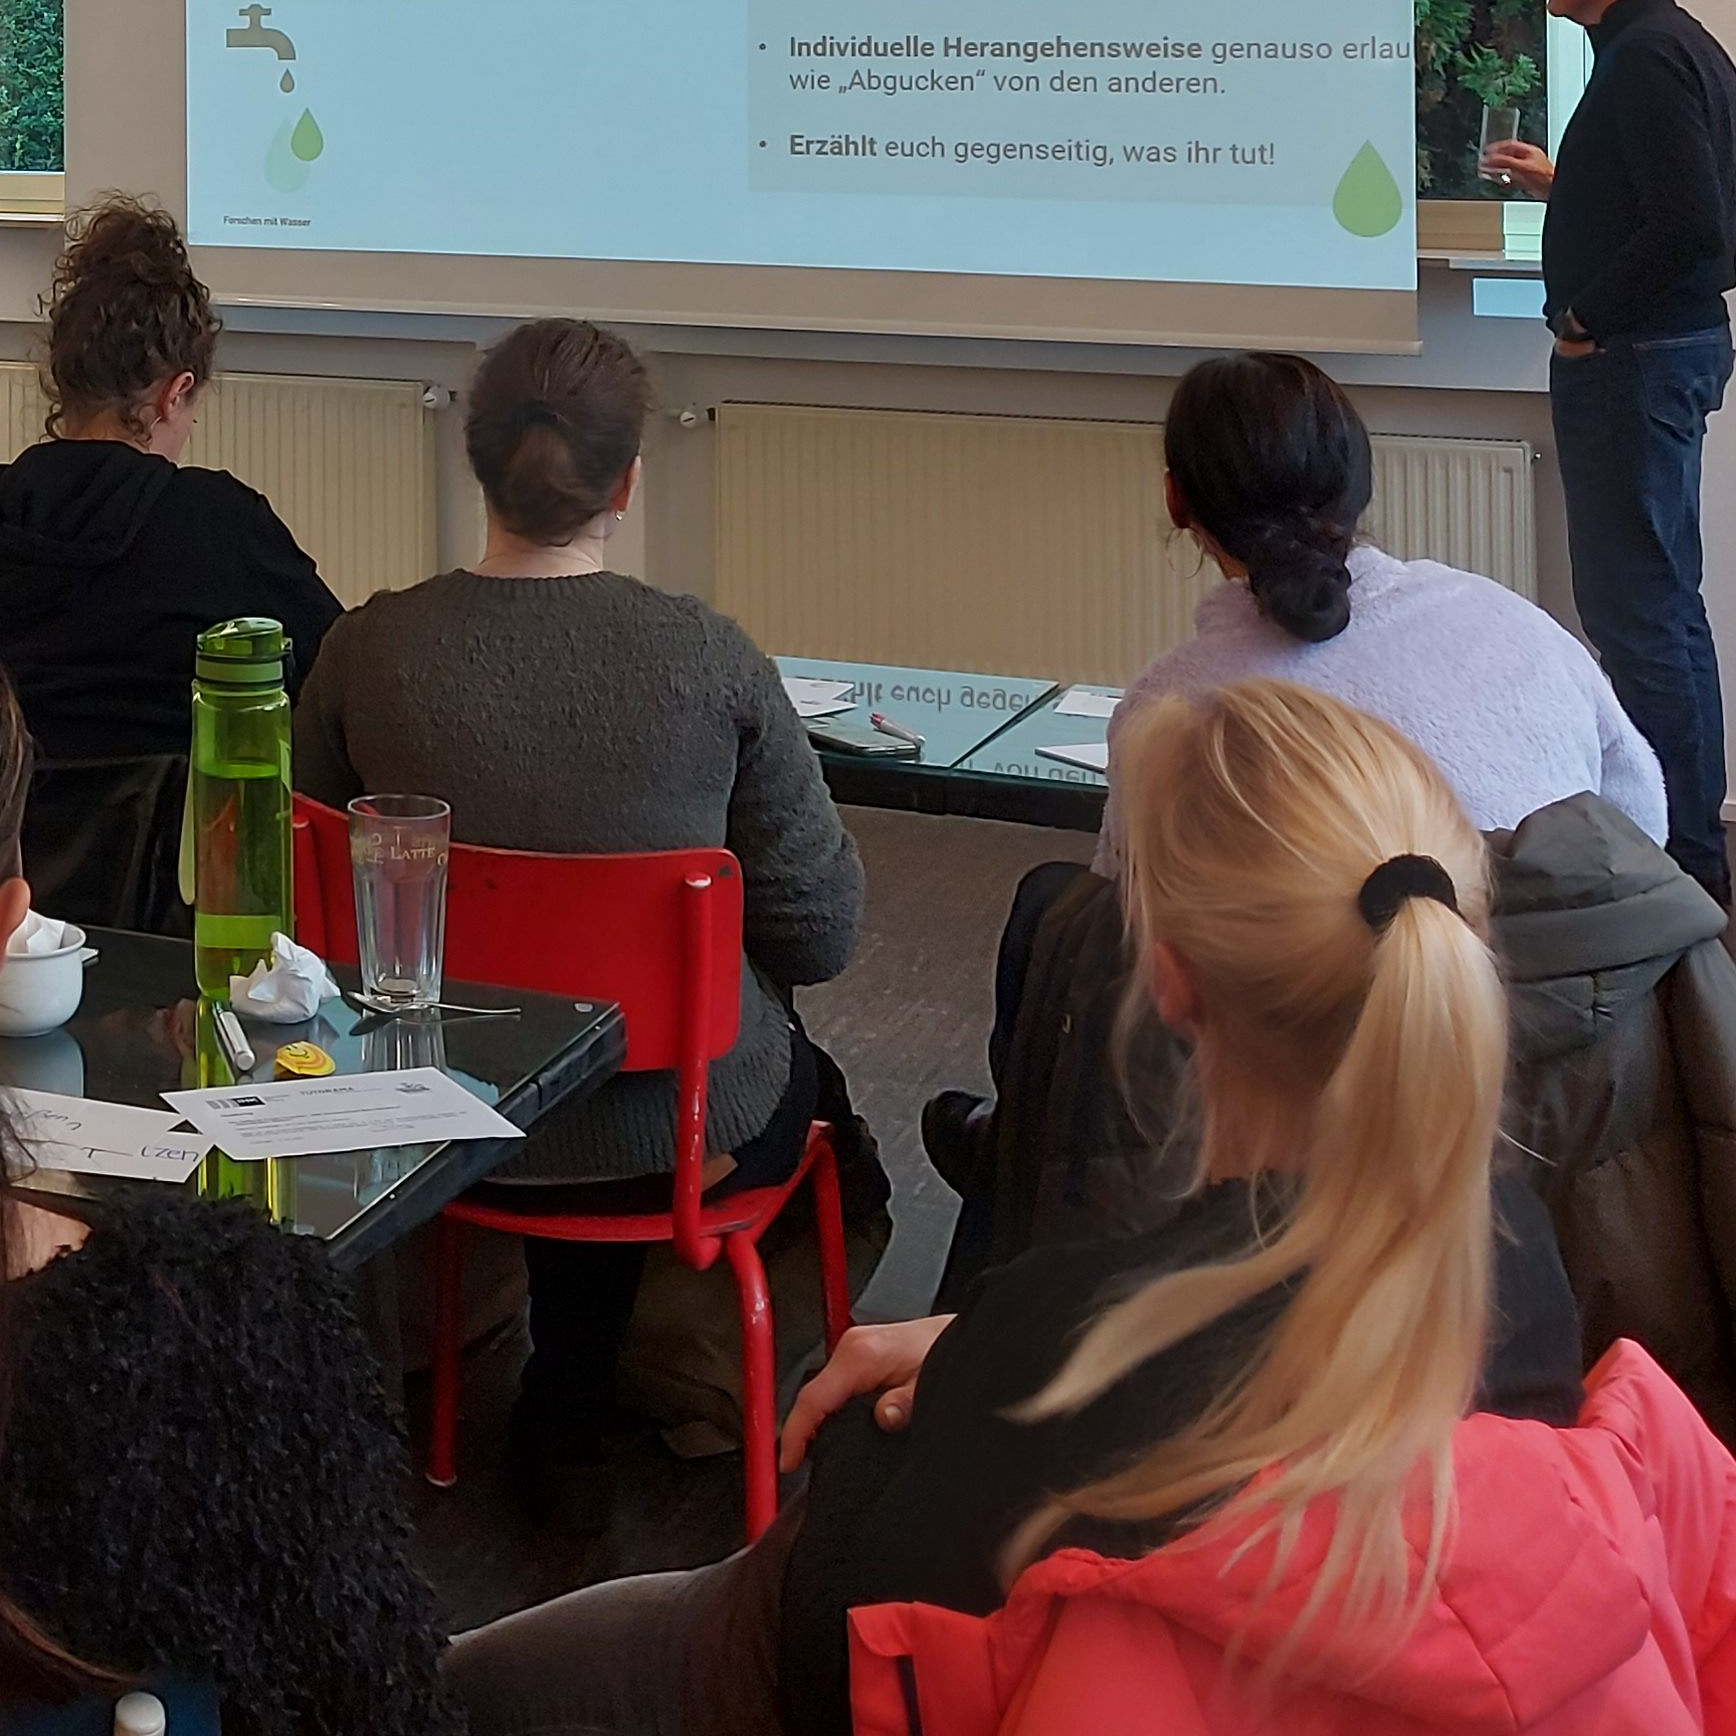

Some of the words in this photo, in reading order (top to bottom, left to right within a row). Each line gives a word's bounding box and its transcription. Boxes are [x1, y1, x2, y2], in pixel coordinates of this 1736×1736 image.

[790, 36, 935, 57] Individuelle
[943, 36, 1202, 62] Herangehensweise
[1212, 40, 1333, 64] genauso
[1342, 36, 1411, 60] erlau
[790, 69, 830, 90] wie
[994, 74, 1039, 92] von
[1049, 70, 1098, 92] den
[1108, 70, 1225, 94] anderen.
[790, 134, 877, 156] Erzählt
[884, 136, 945, 158] euch
[954, 138, 1114, 166] gegenseitig,
[1123, 144, 1177, 163] was
[1187, 141, 1222, 164] ihr
[1231, 143, 1275, 165] tut!
[223, 215, 262, 226] Forschen
[264, 217, 278, 227] mit
[279, 217, 312, 227] Wasser
